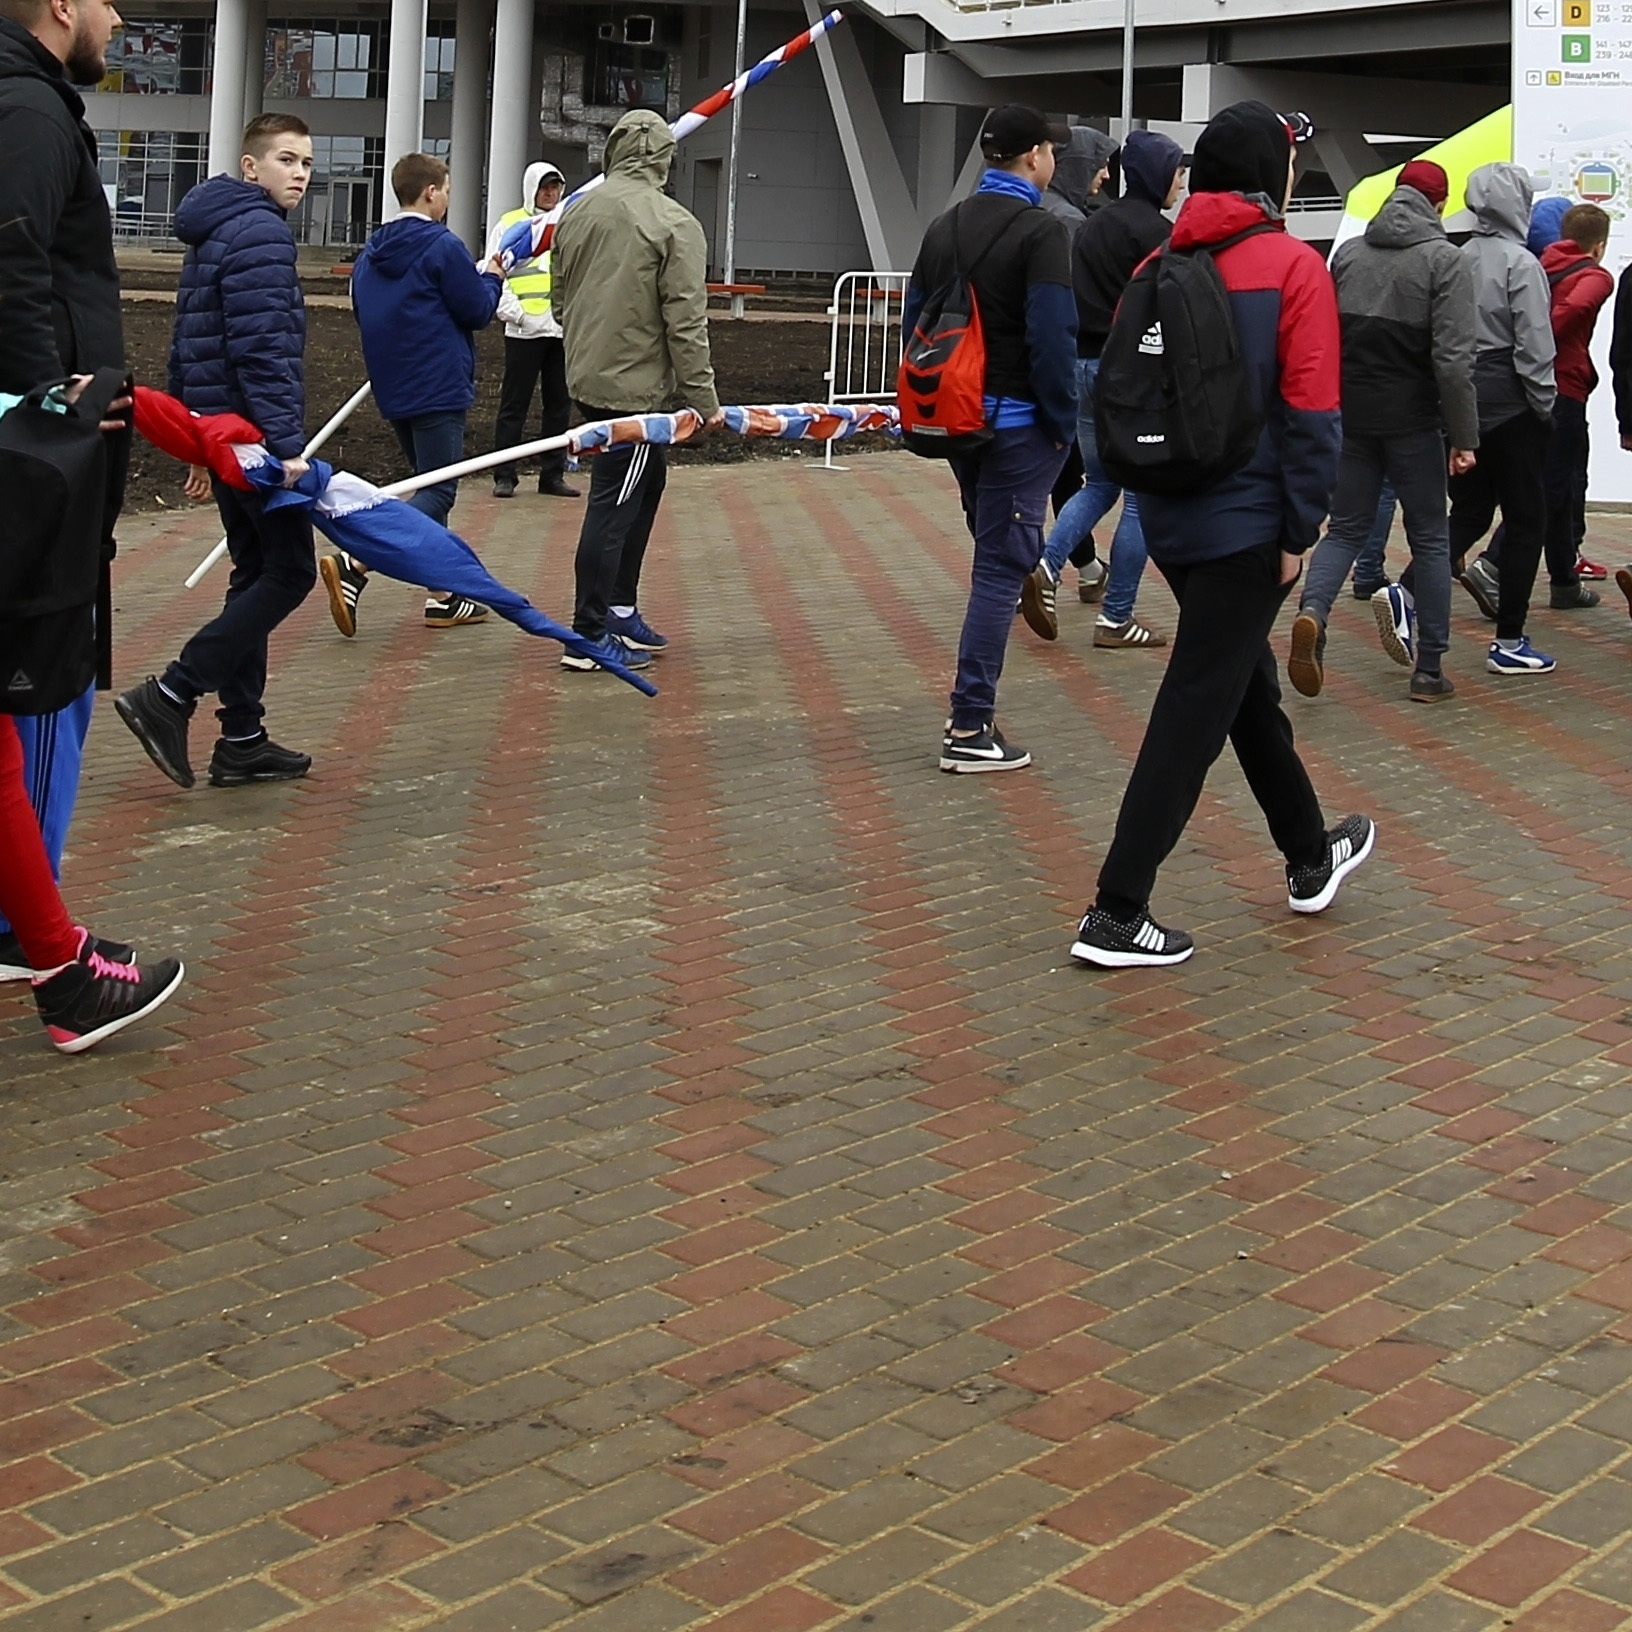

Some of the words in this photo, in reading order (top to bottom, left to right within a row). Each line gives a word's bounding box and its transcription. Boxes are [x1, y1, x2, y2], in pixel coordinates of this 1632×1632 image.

[1571, 5, 1582, 19] D
[1596, 4, 1610, 13] 123
[1596, 14, 1611, 23] 216
[1570, 42, 1583, 56] B
[1596, 40, 1608, 49] 141
[1619, 40, 1632, 49] 147
[1596, 50, 1612, 59] 239
[1601, 71, 1620, 79] МГН
